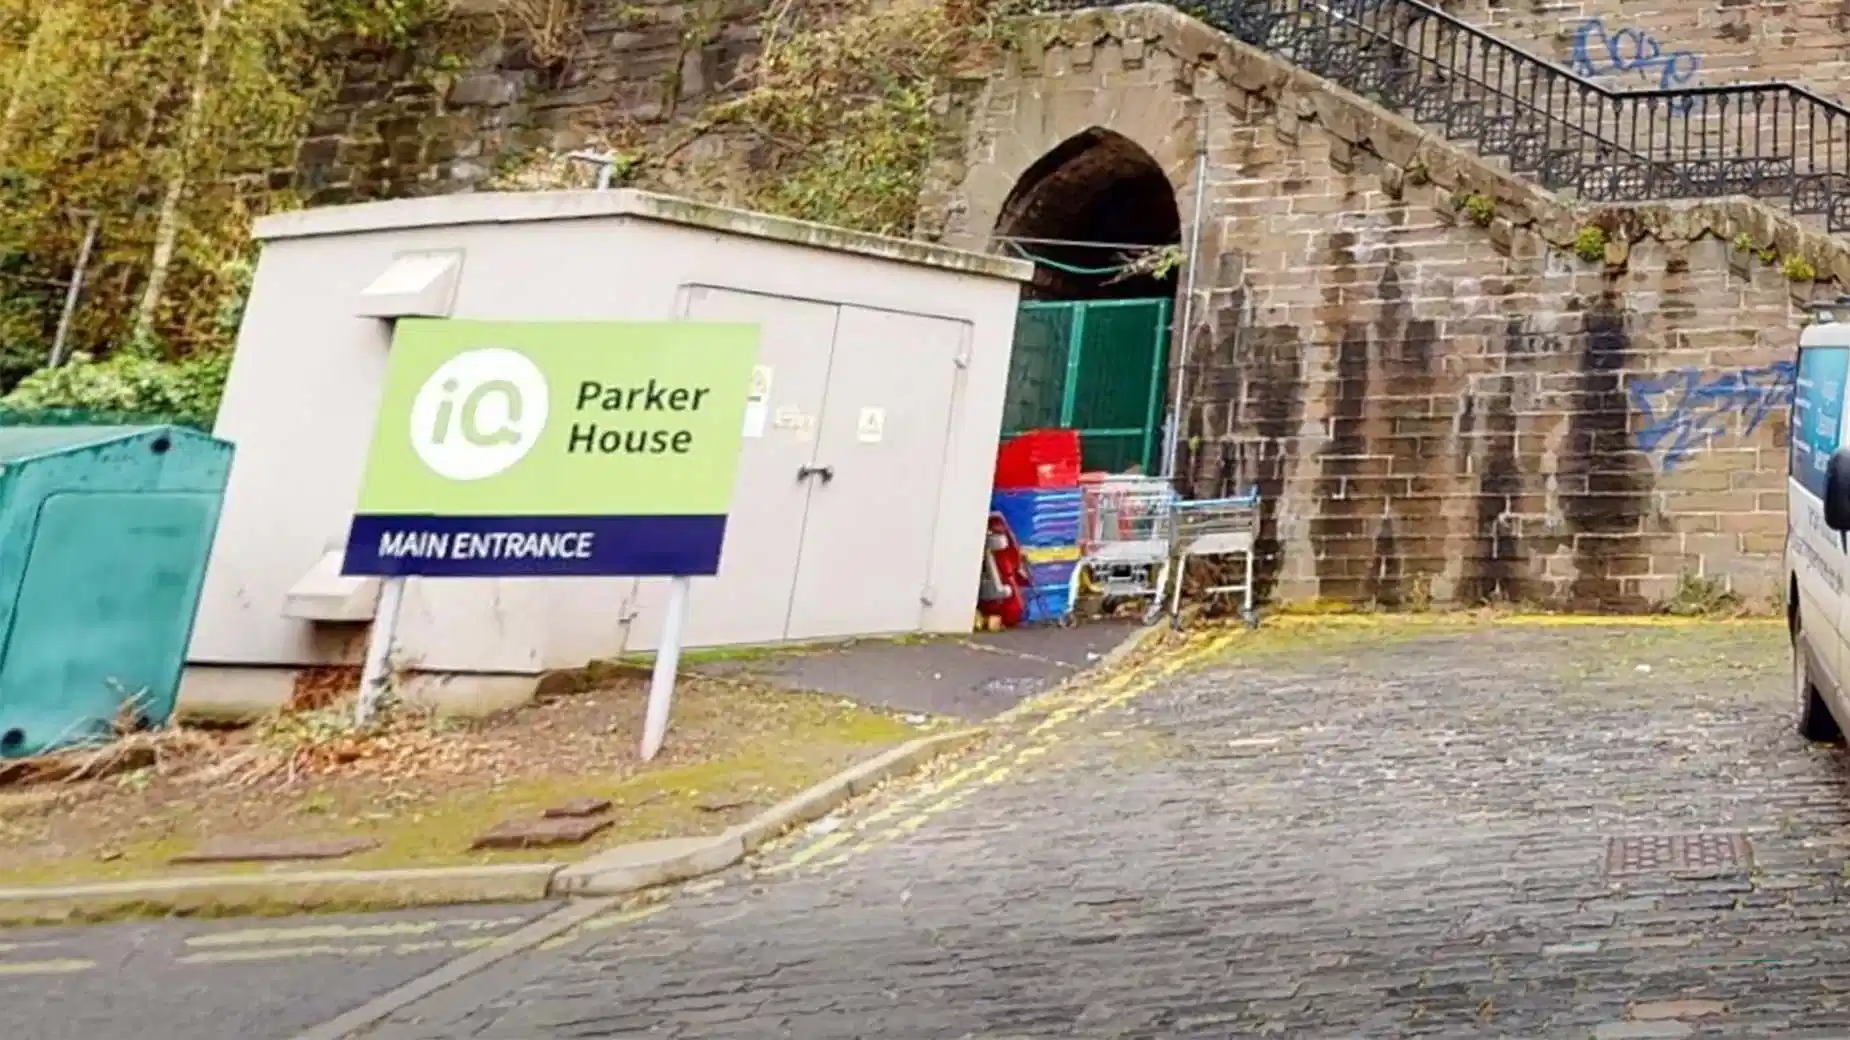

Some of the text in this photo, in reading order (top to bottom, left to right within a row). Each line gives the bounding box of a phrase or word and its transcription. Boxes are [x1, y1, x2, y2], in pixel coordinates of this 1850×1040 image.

[576, 378, 710, 411] Parker
[431, 377, 522, 446] iQ
[568, 423, 692, 453] House
[379, 531, 594, 560] MAIN ENTRANCE
